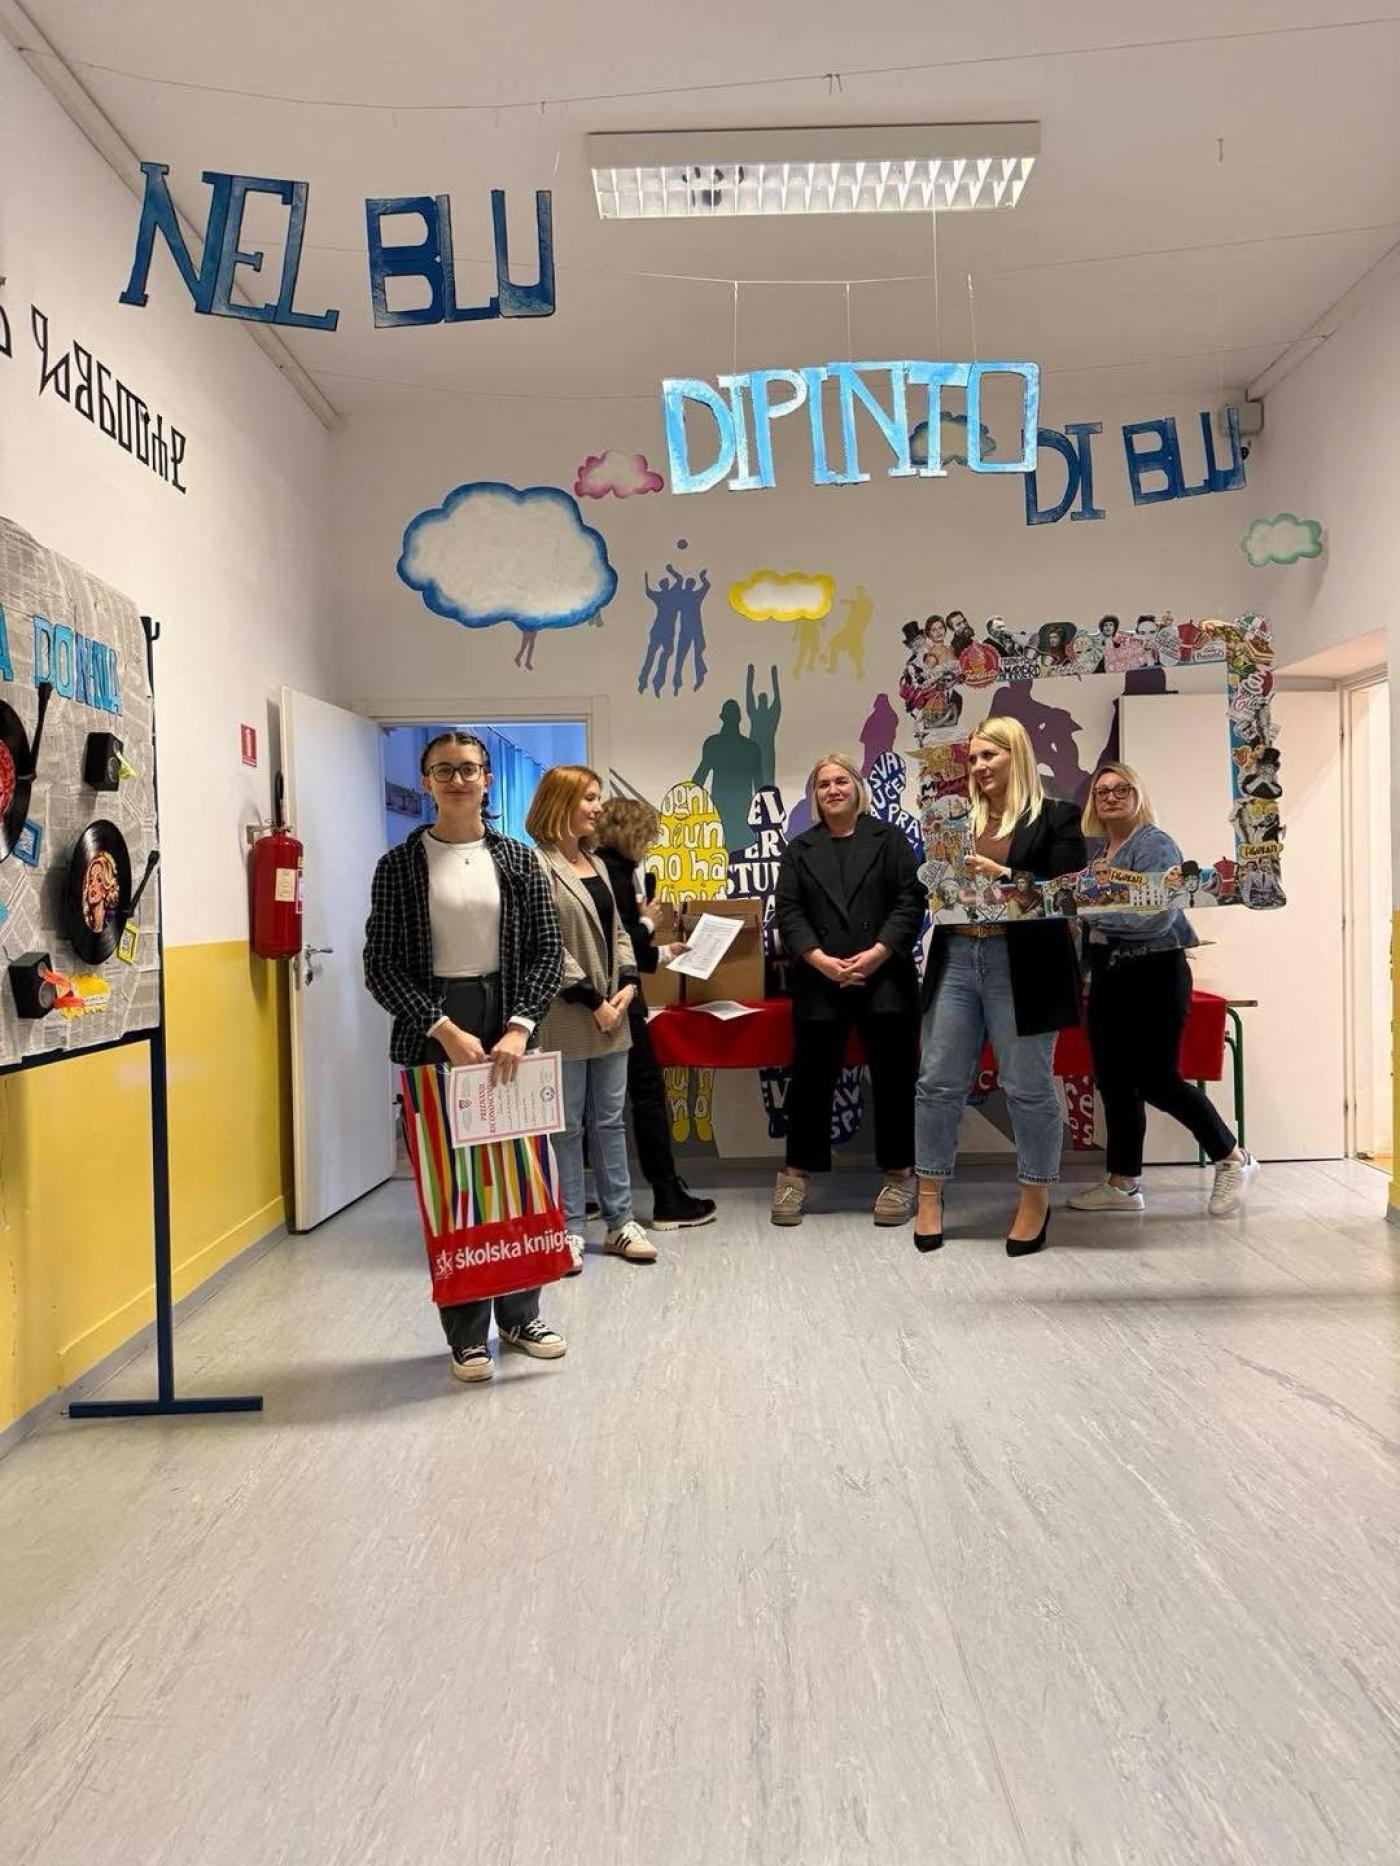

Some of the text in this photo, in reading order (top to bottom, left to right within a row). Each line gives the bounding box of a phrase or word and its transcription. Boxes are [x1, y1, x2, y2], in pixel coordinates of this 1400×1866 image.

[119, 161, 339, 332] NEL
[365, 189, 556, 328] BLU
[662, 360, 1040, 494] DIPINTO
[1021, 405, 1247, 526] DI BLU
[34, 613, 123, 717] DONNA
[888, 803, 925, 841] PRA
[455, 1239, 521, 1270] školska
